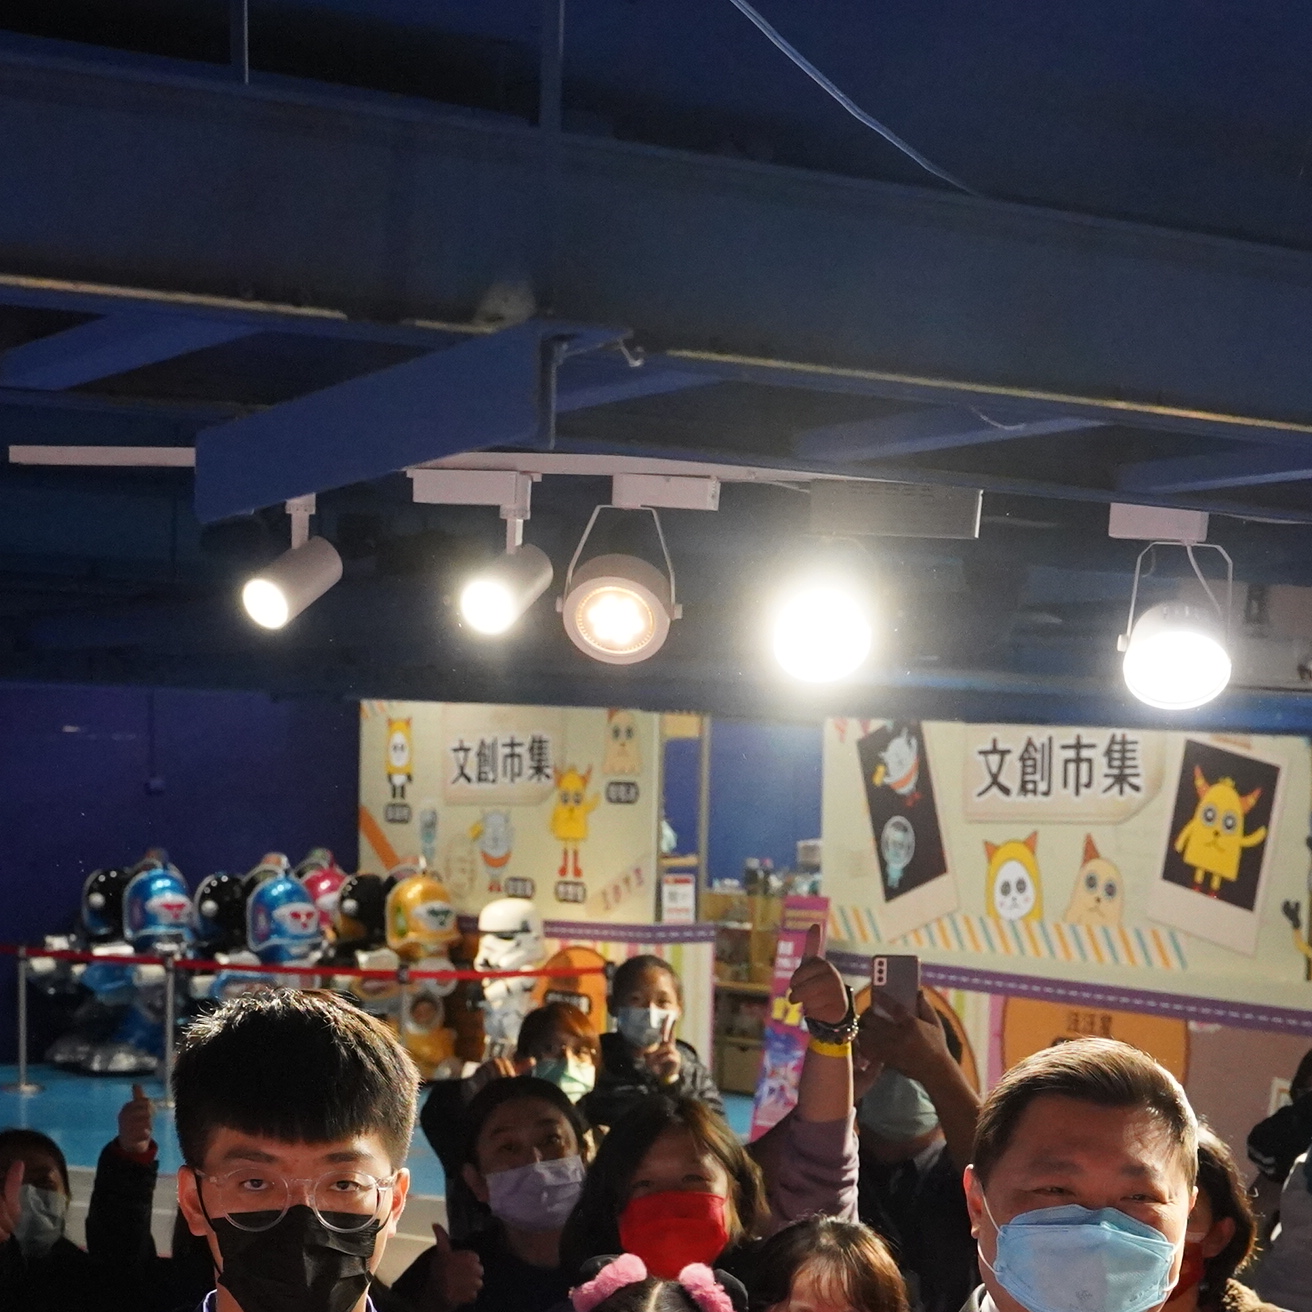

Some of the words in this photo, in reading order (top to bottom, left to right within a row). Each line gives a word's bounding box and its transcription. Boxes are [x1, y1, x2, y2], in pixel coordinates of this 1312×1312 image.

[451, 735, 554, 785] 文創市集
[977, 733, 1142, 797] 文創市集
